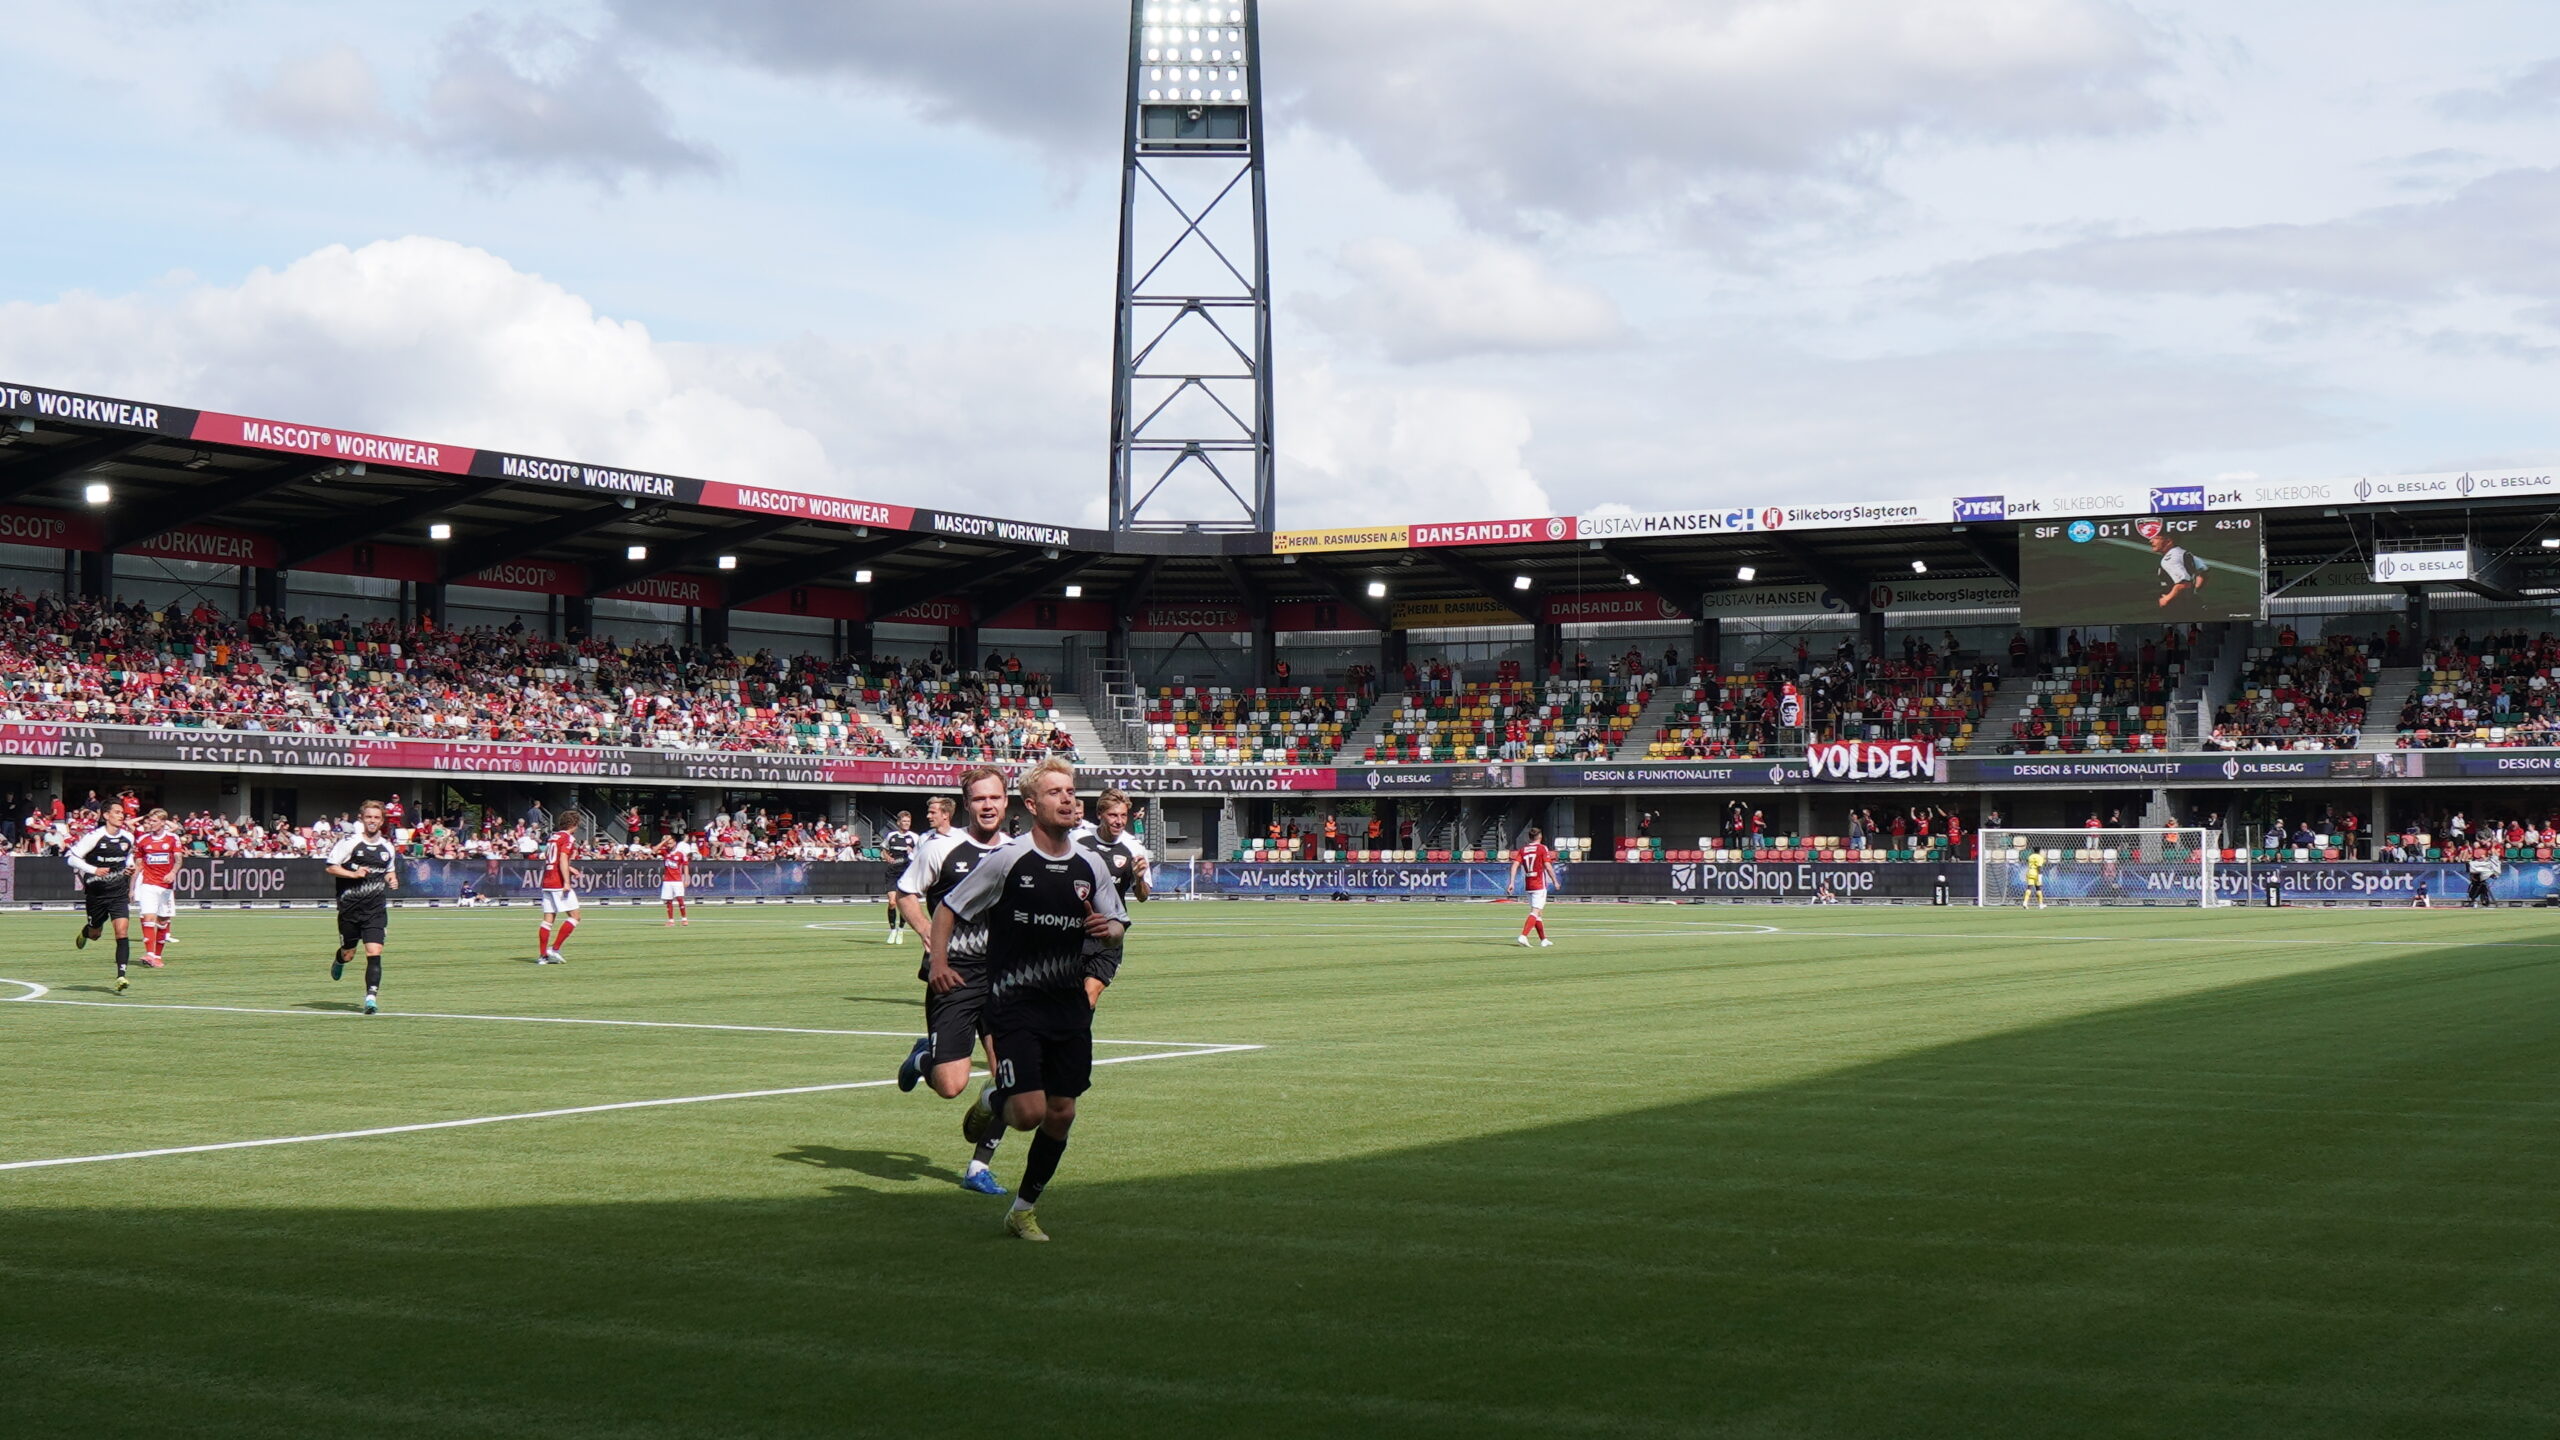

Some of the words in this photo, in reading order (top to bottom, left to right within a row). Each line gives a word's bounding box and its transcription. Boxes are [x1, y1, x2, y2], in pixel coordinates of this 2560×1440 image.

[37, 392, 159, 429] WORKWEAR
[335, 435, 440, 466] WORKWEAR
[583, 467, 674, 496] WORKWEAR
[2377, 483, 2394, 493] OL
[2398, 480, 2446, 492] BESLAG
[2480, 478, 2496, 489] OL
[2500, 475, 2552, 487] BESLAG
[1962, 500, 2003, 516] JYSK
[2008, 500, 2041, 516] park
[2053, 495, 2125, 512] SILKEBORG
[2160, 490, 2203, 506] JYSK
[2208, 490, 2242, 506] park
[2255, 484, 2331, 502] SILKEBORG
[809, 497, 889, 524] WORKWEAR
[997, 522, 1070, 546] WORKWEAR
[1416, 523, 1534, 544] DANSAND.DK
[2035, 526, 2060, 539] SIF
[2166, 520, 2198, 533] FCF
[2215, 519, 2251, 530] 43:10
[1289, 535, 1322, 547] HERM.
[1324, 533, 1389, 545] RASMUSSEN
[1390, 531, 1408, 543] A/S
[2400, 562, 2416, 572] OL
[2419, 560, 2465, 571] BESLAG
[617, 579, 700, 601] OOTWEAR
[1551, 601, 1644, 616] DANSAND.DK
[1808, 742, 1935, 780] VOLDEN
[2014, 765, 2060, 776] DESIGN
[2063, 765, 2072, 775] &
[2074, 763, 2181, 775] FUNKTIONALITET
[2243, 763, 2258, 773] OL
[2260, 762, 2304, 773] BESLAG
[2499, 758, 2551, 770] DESIGN
[1383, 775, 1394, 784] OL
[1397, 774, 1431, 784] BESLAG
[1583, 770, 1626, 781] DESIGN
[1628, 770, 1636, 780] &
[1638, 768, 1733, 780] FUNKTIONALITET
[1787, 770, 1800, 779] OL
[1523, 853, 1537, 873] 17
[210, 860, 285, 899] Europe
[606, 869, 620, 888] til
[625, 867, 643, 888] alt
[648, 868, 662, 889] fo
[1239, 869, 1324, 890] AV-udstyr
[1327, 869, 1345, 887] til
[1347, 869, 1369, 887] alt
[1372, 868, 1397, 887] for
[1399, 870, 1448, 890] Sport
[1703, 863, 1793, 895] ProShop
[1798, 864, 1873, 896] Europe
[2284, 871, 2314, 891] alt
[2317, 871, 2346, 891] for
[2351, 871, 2414, 895] Sport
